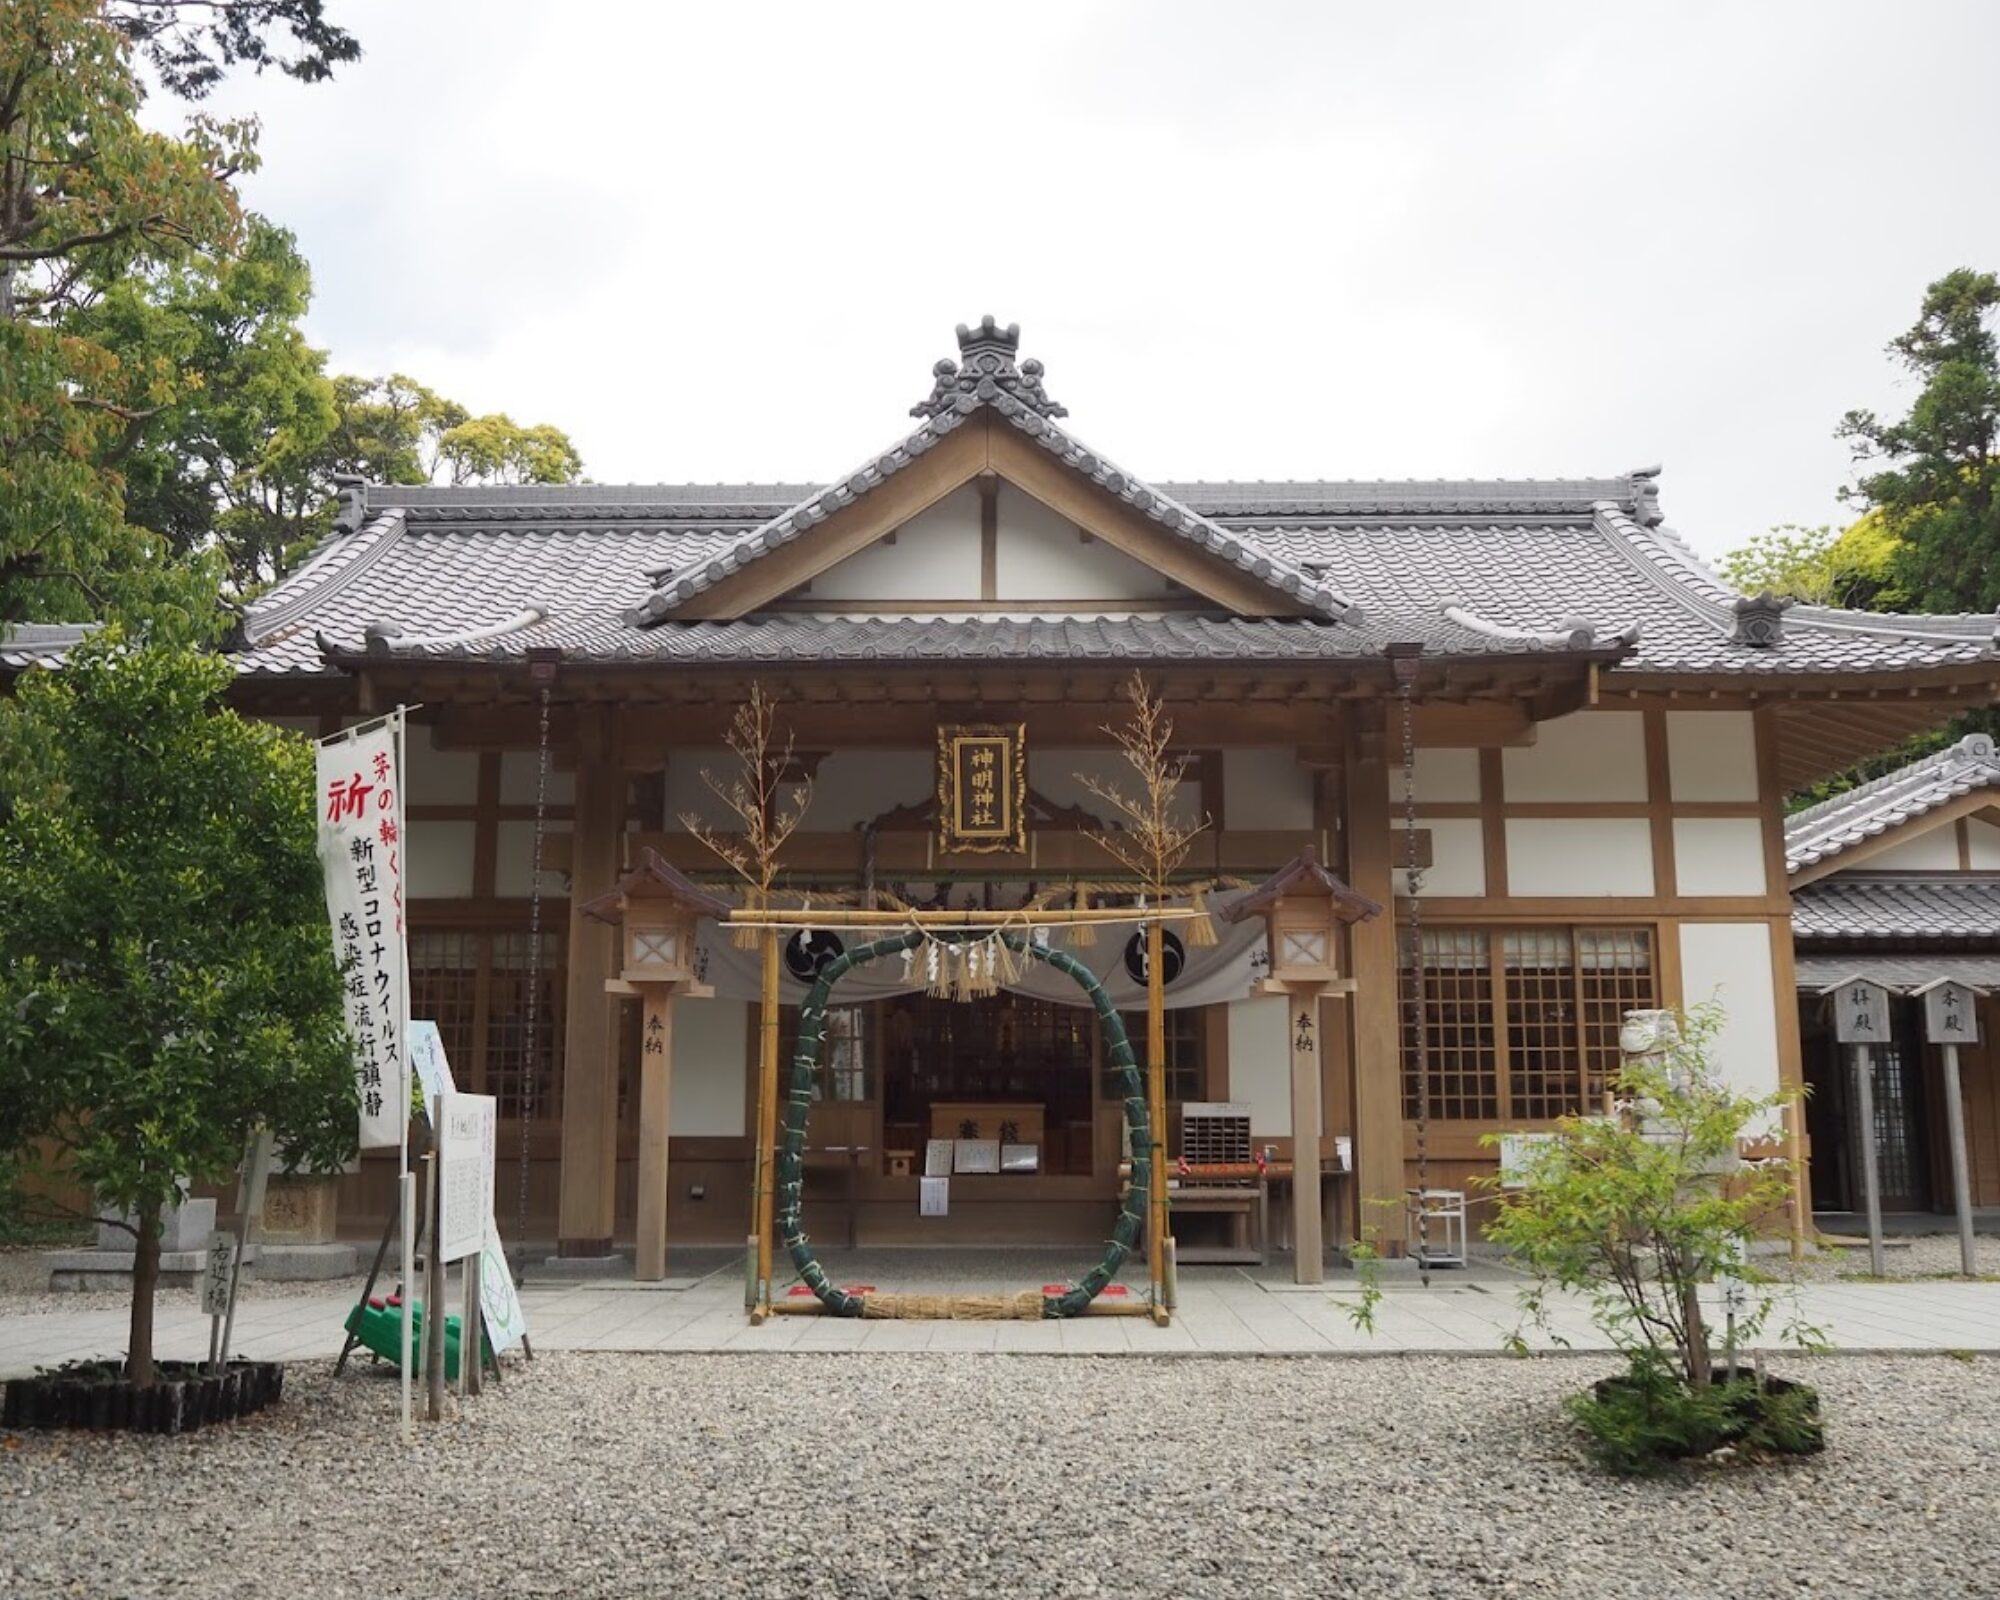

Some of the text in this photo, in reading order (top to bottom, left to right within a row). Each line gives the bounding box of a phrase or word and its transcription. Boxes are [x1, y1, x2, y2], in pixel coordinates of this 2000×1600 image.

[326, 773, 374, 823] 祈
[970, 747, 996, 826] 神明神社
[349, 836, 400, 1064] 新型コロナウイルス
[338, 912, 385, 1118] 感染症流行鎮静
[1296, 1011, 1315, 1053] 奉納
[1852, 988, 1874, 1032] 拝殿
[1943, 989, 1964, 1032] 本殿
[645, 1013, 665, 1055] 奉納
